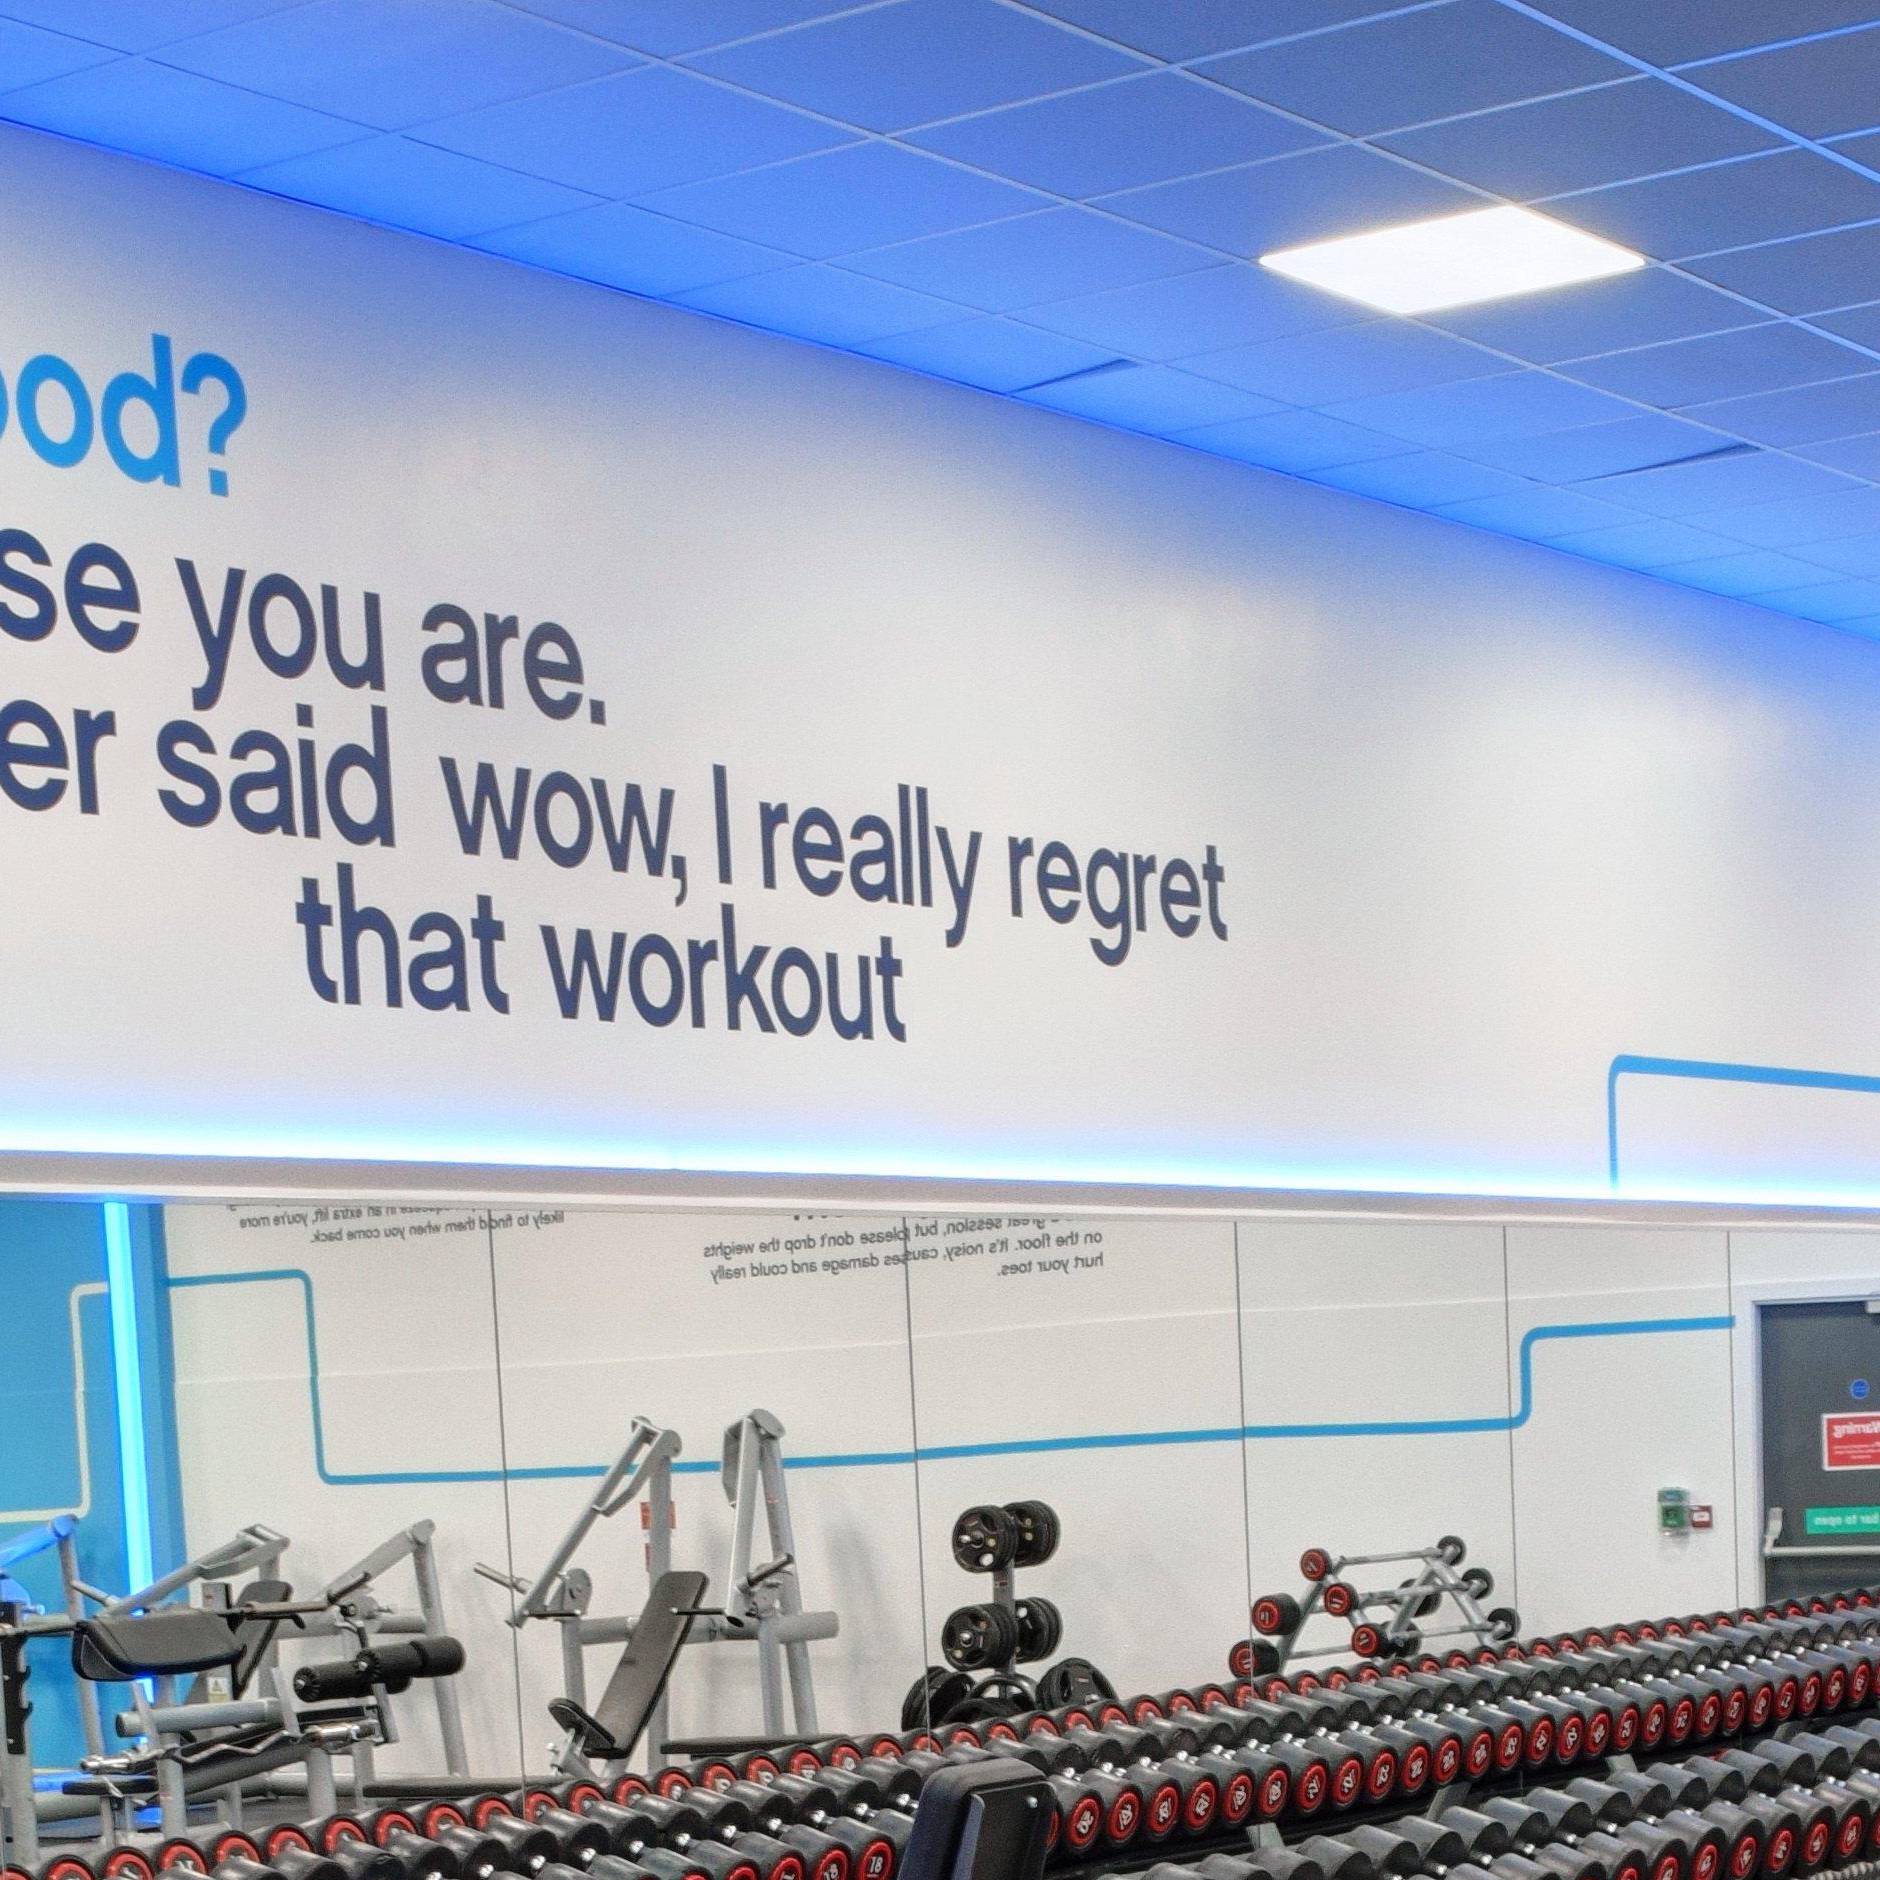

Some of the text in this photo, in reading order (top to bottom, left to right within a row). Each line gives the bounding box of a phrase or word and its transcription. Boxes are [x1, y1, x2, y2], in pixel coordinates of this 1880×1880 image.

[175, 557, 385, 711] you
[421, 602, 607, 726] are.
[156, 703, 396, 847] said
[439, 754, 690, 907] wow,
[712, 762, 733, 886] I
[758, 783, 982, 948] really
[1007, 834, 1229, 967] regret
[297, 861, 907, 1044] that workout
[871, 1856, 883, 1873] 18
